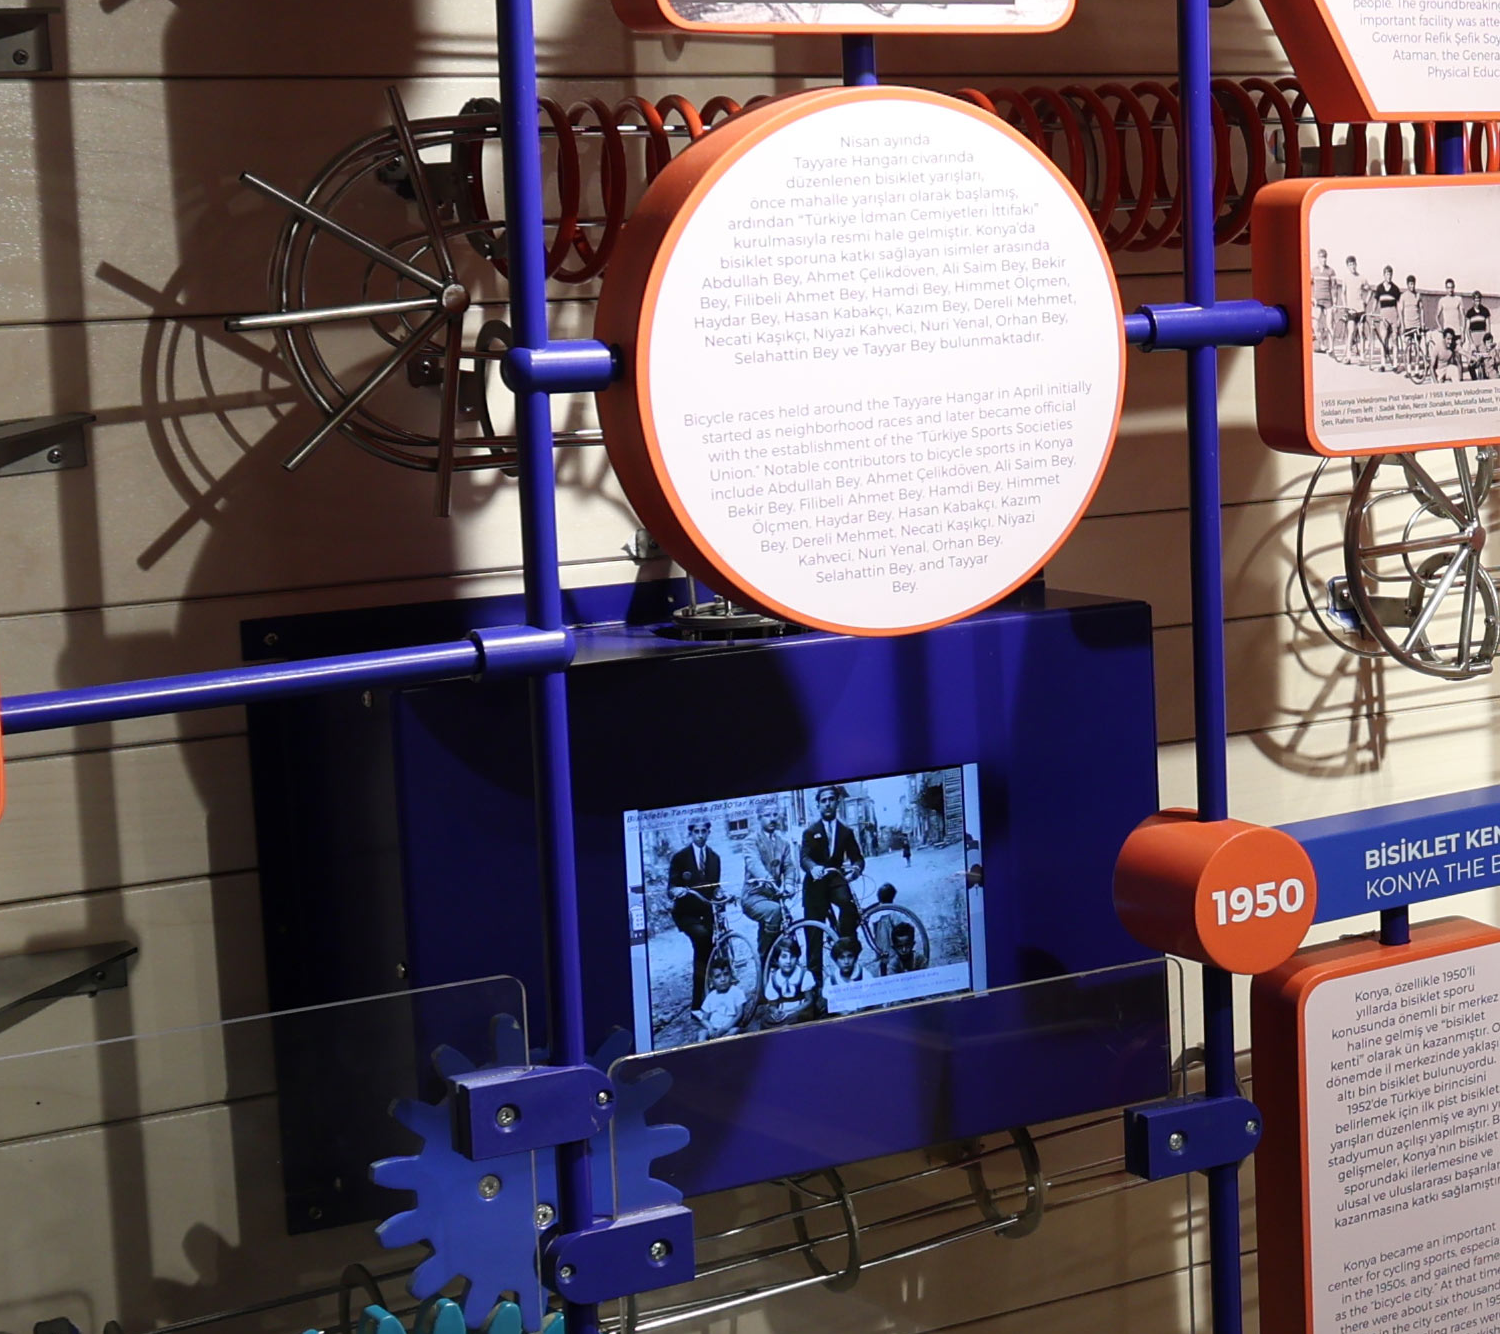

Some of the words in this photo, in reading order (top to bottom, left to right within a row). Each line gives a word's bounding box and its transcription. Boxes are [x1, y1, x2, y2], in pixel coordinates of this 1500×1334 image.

[1426, 65, 1470, 81] Physical
[839, 134, 880, 148] Nisan
[882, 132, 930, 150] ayında
[1364, 833, 1460, 871] BİSİKLET
[1366, 868, 1440, 900] KONYA
[1443, 853, 1485, 883] THE
[1211, 877, 1305, 926] 1950
[1354, 986, 1392, 1003] Konya,
[1393, 973, 1440, 994] özellikle
[1441, 964, 1476, 983] 1950'li
